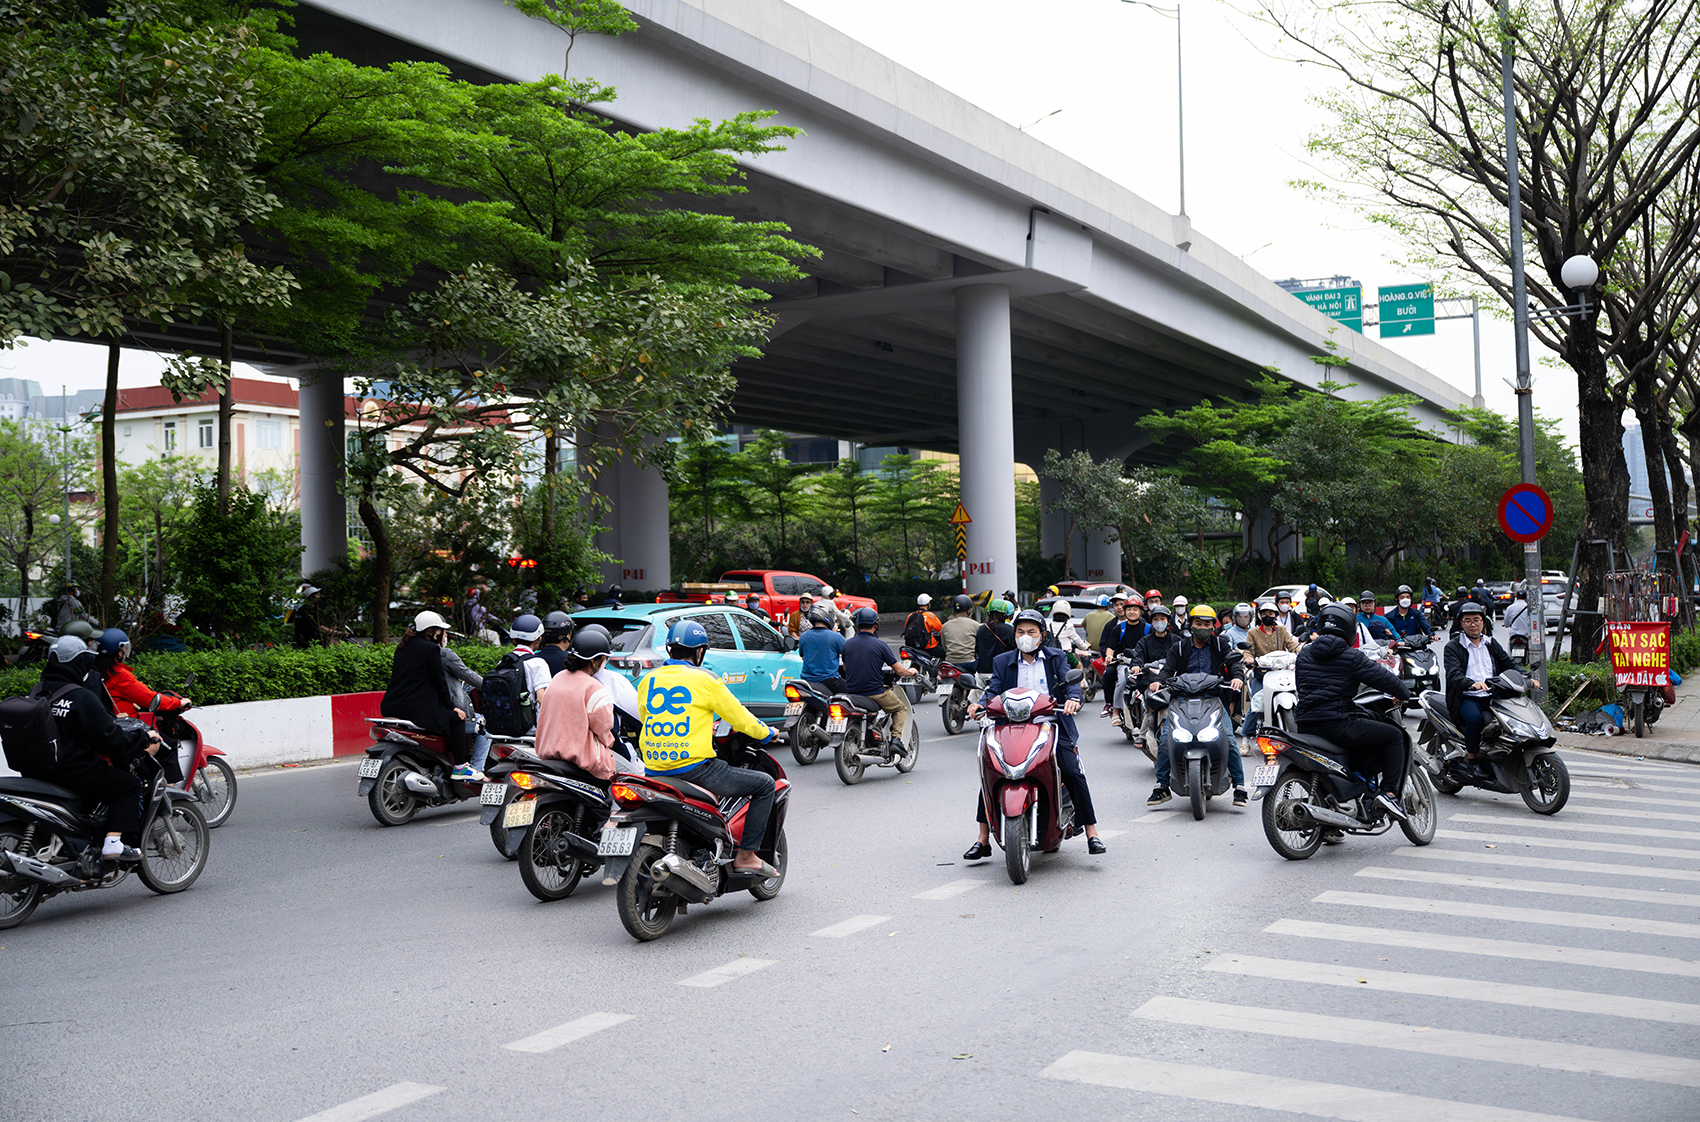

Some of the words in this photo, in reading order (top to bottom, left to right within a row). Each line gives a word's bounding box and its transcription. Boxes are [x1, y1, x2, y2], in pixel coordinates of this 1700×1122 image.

[1305, 293, 1323, 302] VÀNH
[1324, 292, 1336, 300] ĐAI
[1336, 292, 1341, 300] 3
[1317, 302, 1328, 311] HÀ
[1329, 301, 1342, 310] NỘI
[1397, 304, 1417, 316] BƯỞI
[623, 569, 644, 580] P41
[969, 562, 991, 575] P41
[1088, 569, 1104, 577] P40
[1609, 622, 1631, 630] BÁN
[1612, 630, 1637, 648] DÂY
[1640, 632, 1666, 651] SẠC
[1613, 652, 1630, 667] TAI
[1633, 652, 1666, 668] NGHE
[1636, 670, 1654, 686] DÂY
[646, 676, 692, 715] be
[645, 740, 656, 748] Món
[662, 740, 679, 749] cũng
[679, 740, 690, 748] có
[484, 784, 503, 794] 29-L5
[505, 813, 533, 827] 096.50
[607, 829, 631, 841] 17-B1
[600, 841, 632, 854] 565.63
